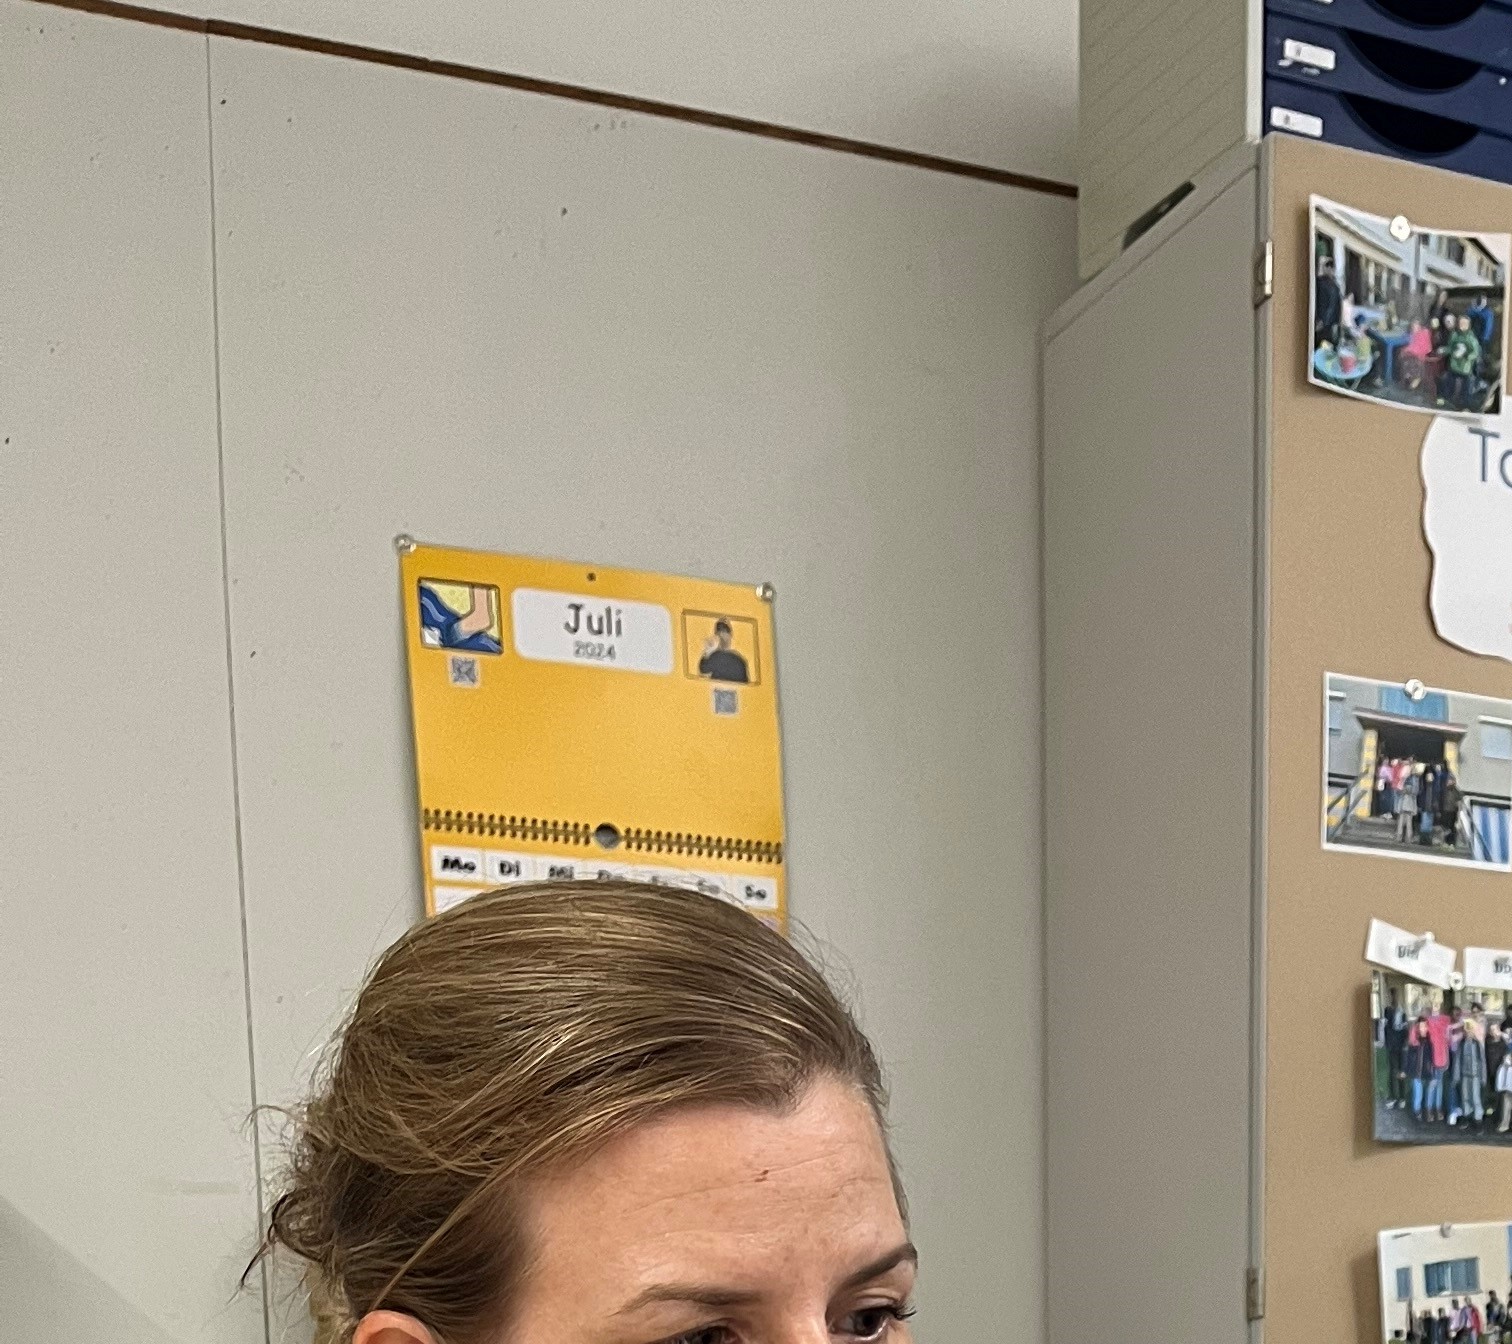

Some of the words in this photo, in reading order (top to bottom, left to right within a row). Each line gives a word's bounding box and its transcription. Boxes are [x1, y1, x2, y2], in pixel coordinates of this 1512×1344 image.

[563, 603, 622, 637] Juli
[573, 640, 616, 661] 2024
[441, 855, 477, 873] Mo
